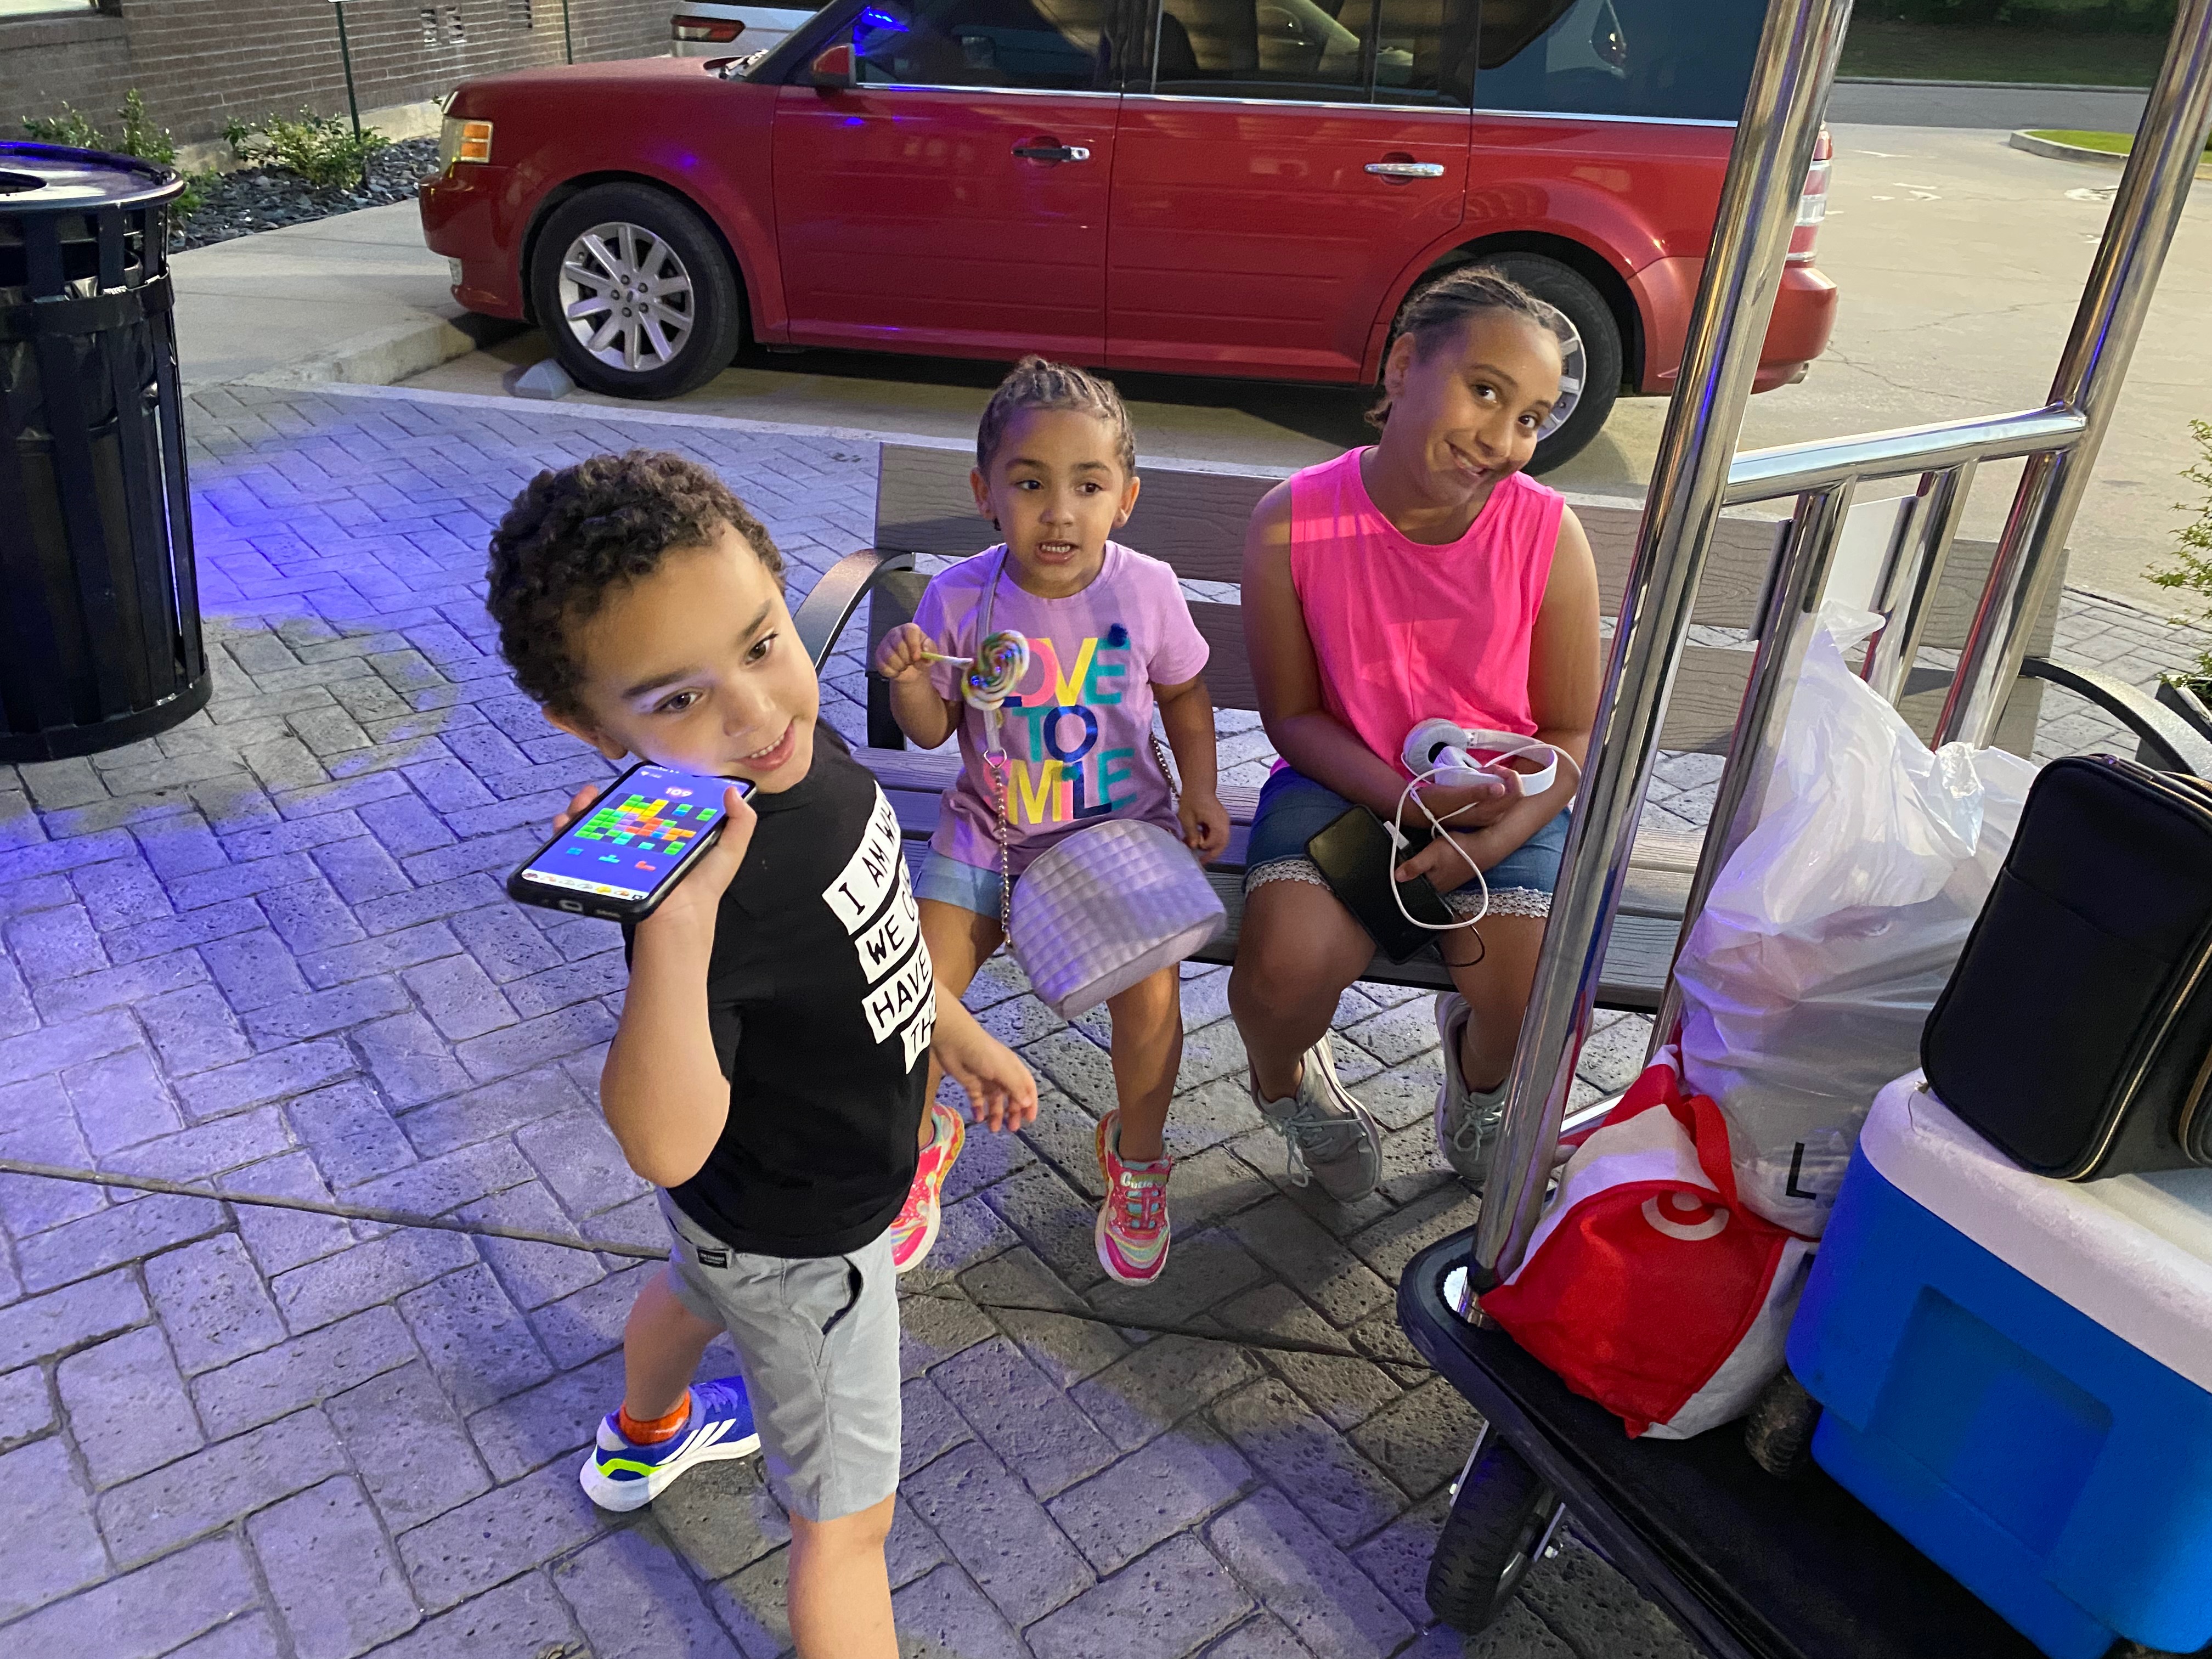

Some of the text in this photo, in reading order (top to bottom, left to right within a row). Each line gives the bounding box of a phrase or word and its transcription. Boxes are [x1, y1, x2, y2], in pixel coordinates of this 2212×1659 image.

[1001, 637, 1131, 708] OVE
[1012, 704, 1098, 763] TO
[665, 787, 693, 797] 109
[838, 797, 898, 916] I AM WH
[866, 915, 905, 966] WE
[872, 946, 929, 1029] HAVE
